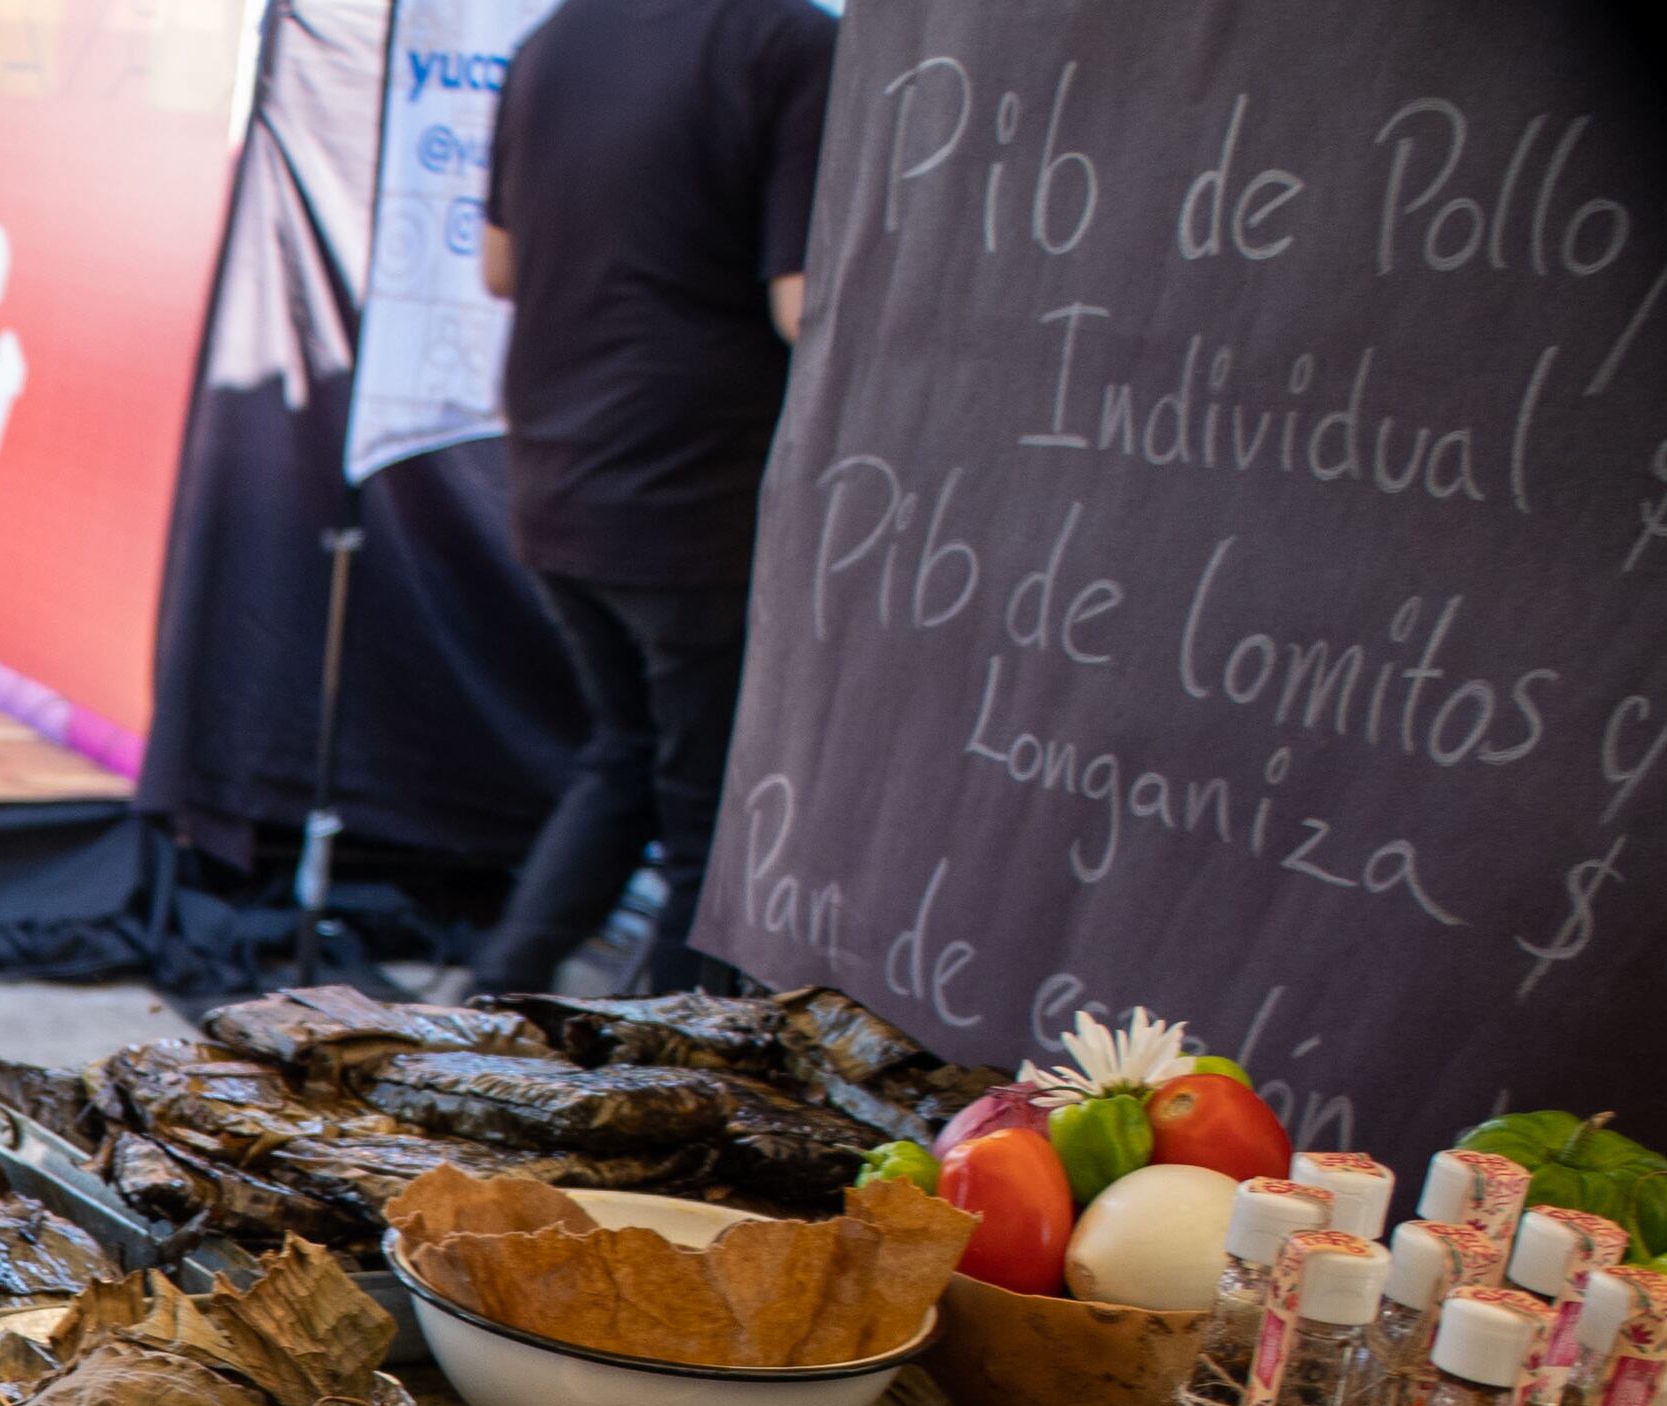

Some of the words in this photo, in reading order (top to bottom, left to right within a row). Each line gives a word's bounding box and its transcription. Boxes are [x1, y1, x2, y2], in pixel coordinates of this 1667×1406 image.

[885, 56, 1098, 255] Pib
[1178, 93, 1305, 260] de
[1019, 302, 1559, 513] Individual
[813, 454, 980, 641] Pib
[1007, 502, 1124, 664] de
[965, 657, 1468, 927] Longaniza
[745, 772, 843, 966] Pan
[885, 858, 983, 1028] de
